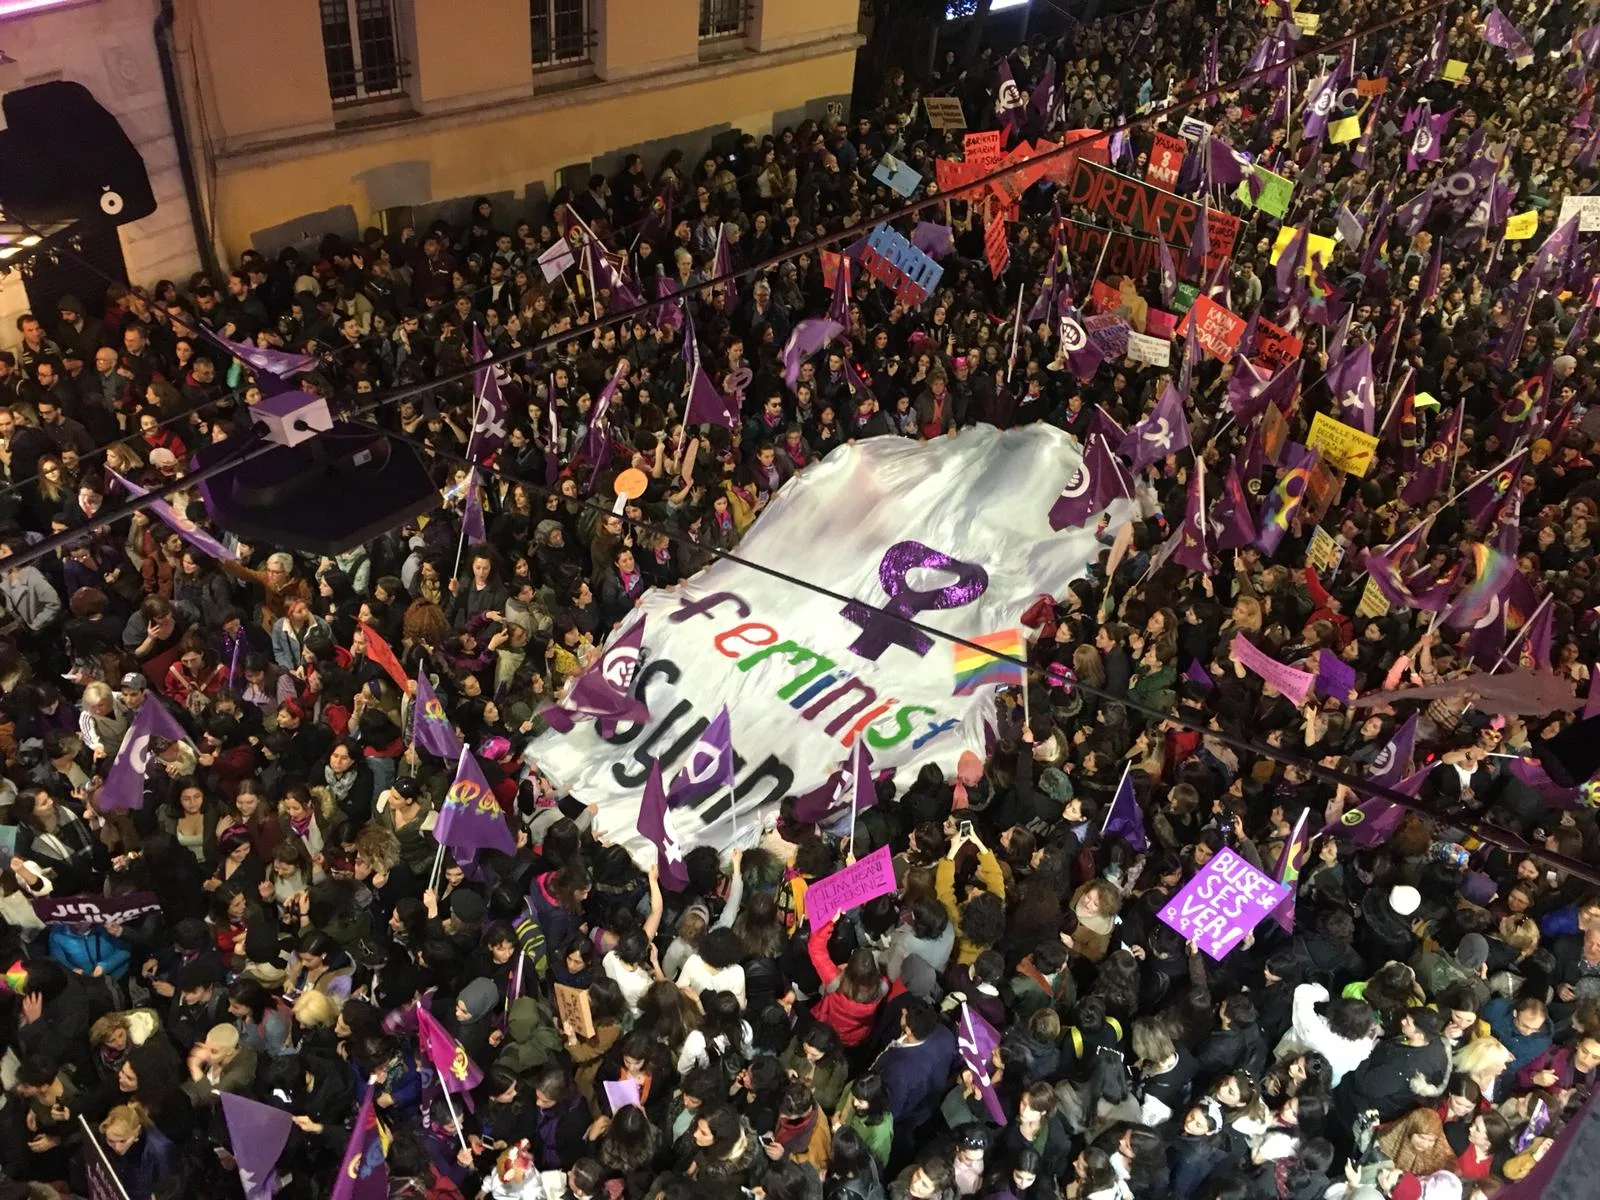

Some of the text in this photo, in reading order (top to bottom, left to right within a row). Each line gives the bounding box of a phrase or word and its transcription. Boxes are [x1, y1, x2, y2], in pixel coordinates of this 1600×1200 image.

[1161, 151, 1172, 168] 8
[1147, 163, 1179, 184] MART
[1206, 307, 1237, 331] KADIN
[668, 591, 960, 750] feminist
[1196, 874, 1249, 918] SES
